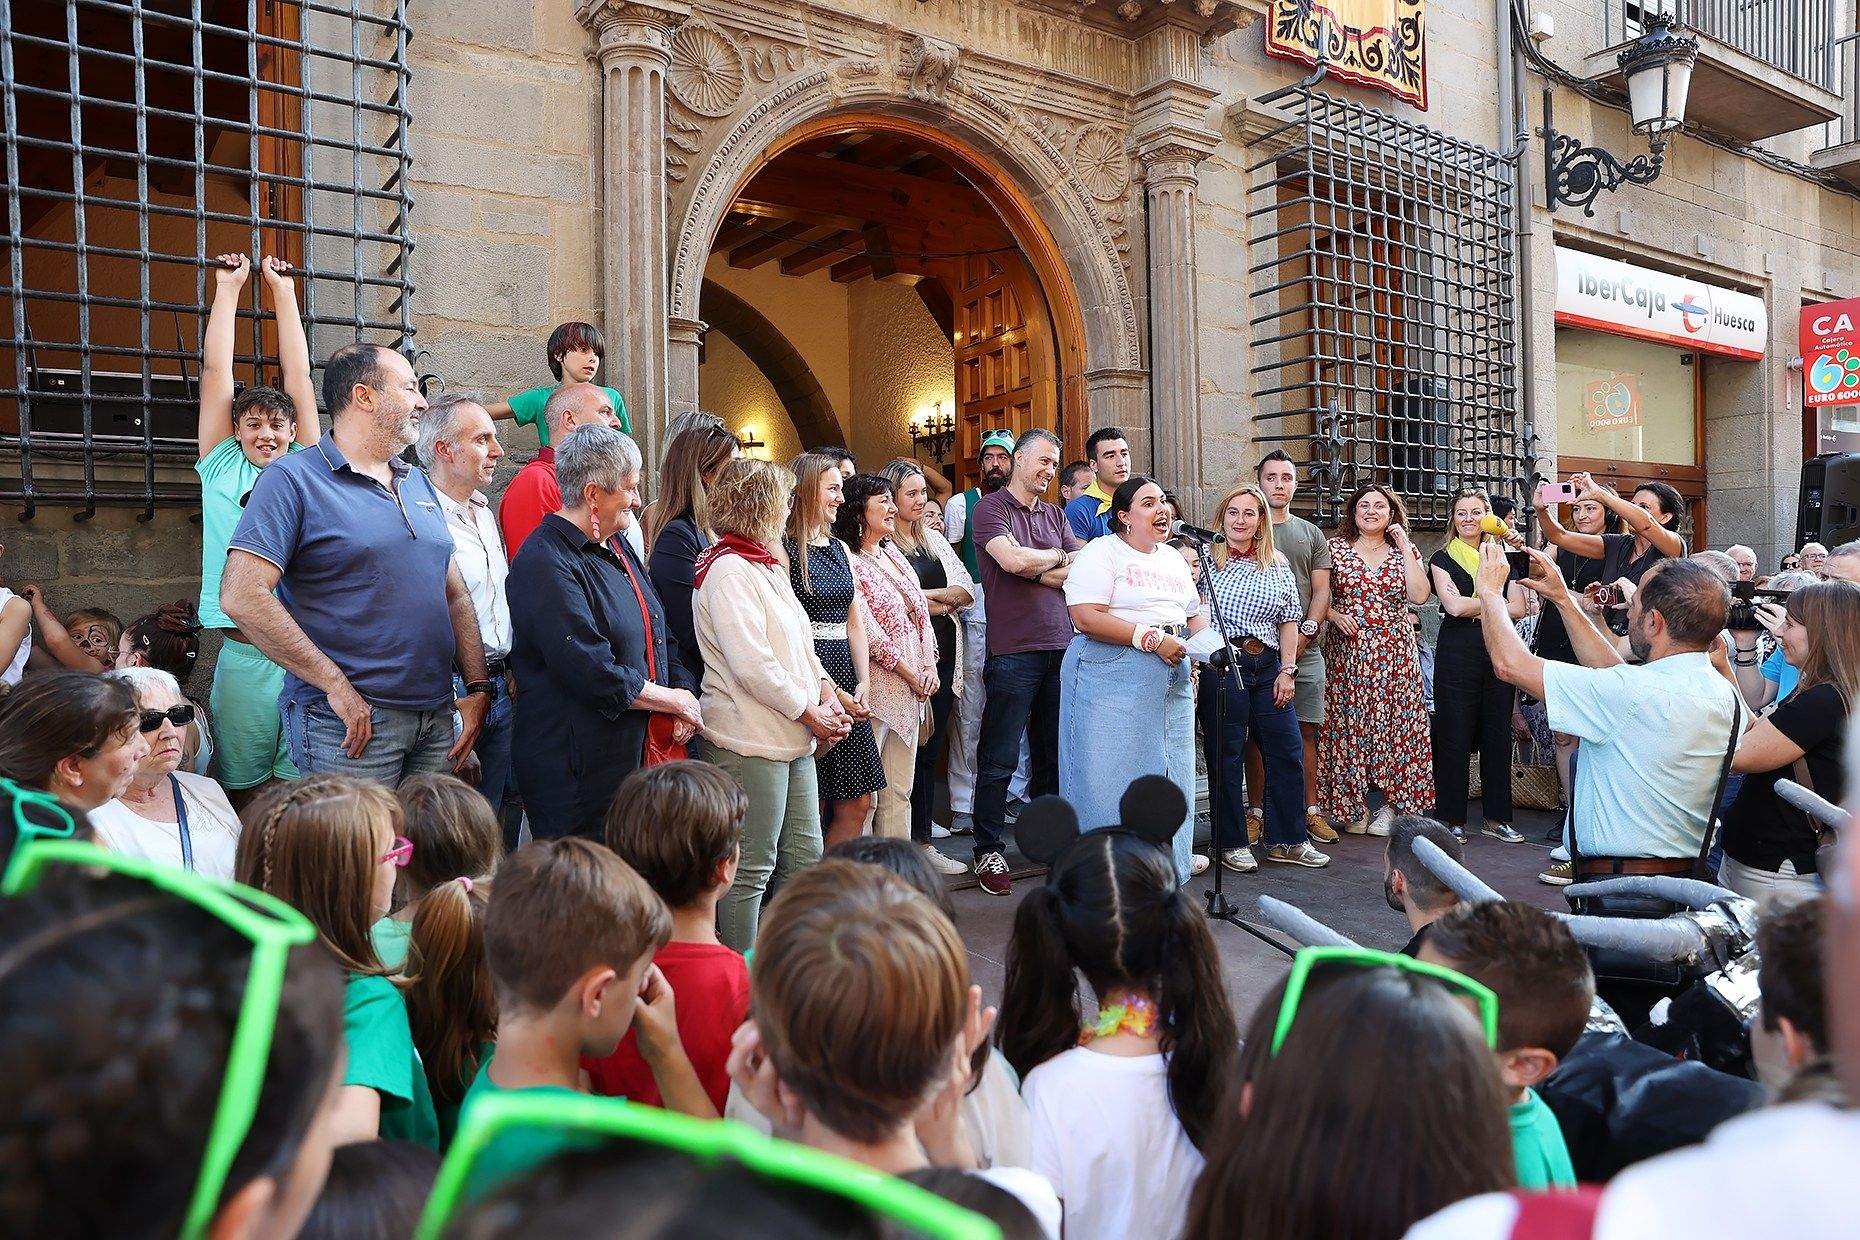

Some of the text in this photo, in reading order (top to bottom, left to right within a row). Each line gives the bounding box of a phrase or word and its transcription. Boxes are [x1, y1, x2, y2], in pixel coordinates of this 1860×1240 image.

[1714, 306, 1755, 332] Huesca
[1812, 313, 1854, 336] CA
[1821, 336, 1845, 345] Cajero
[1808, 389, 1860, 403] EURO 600
